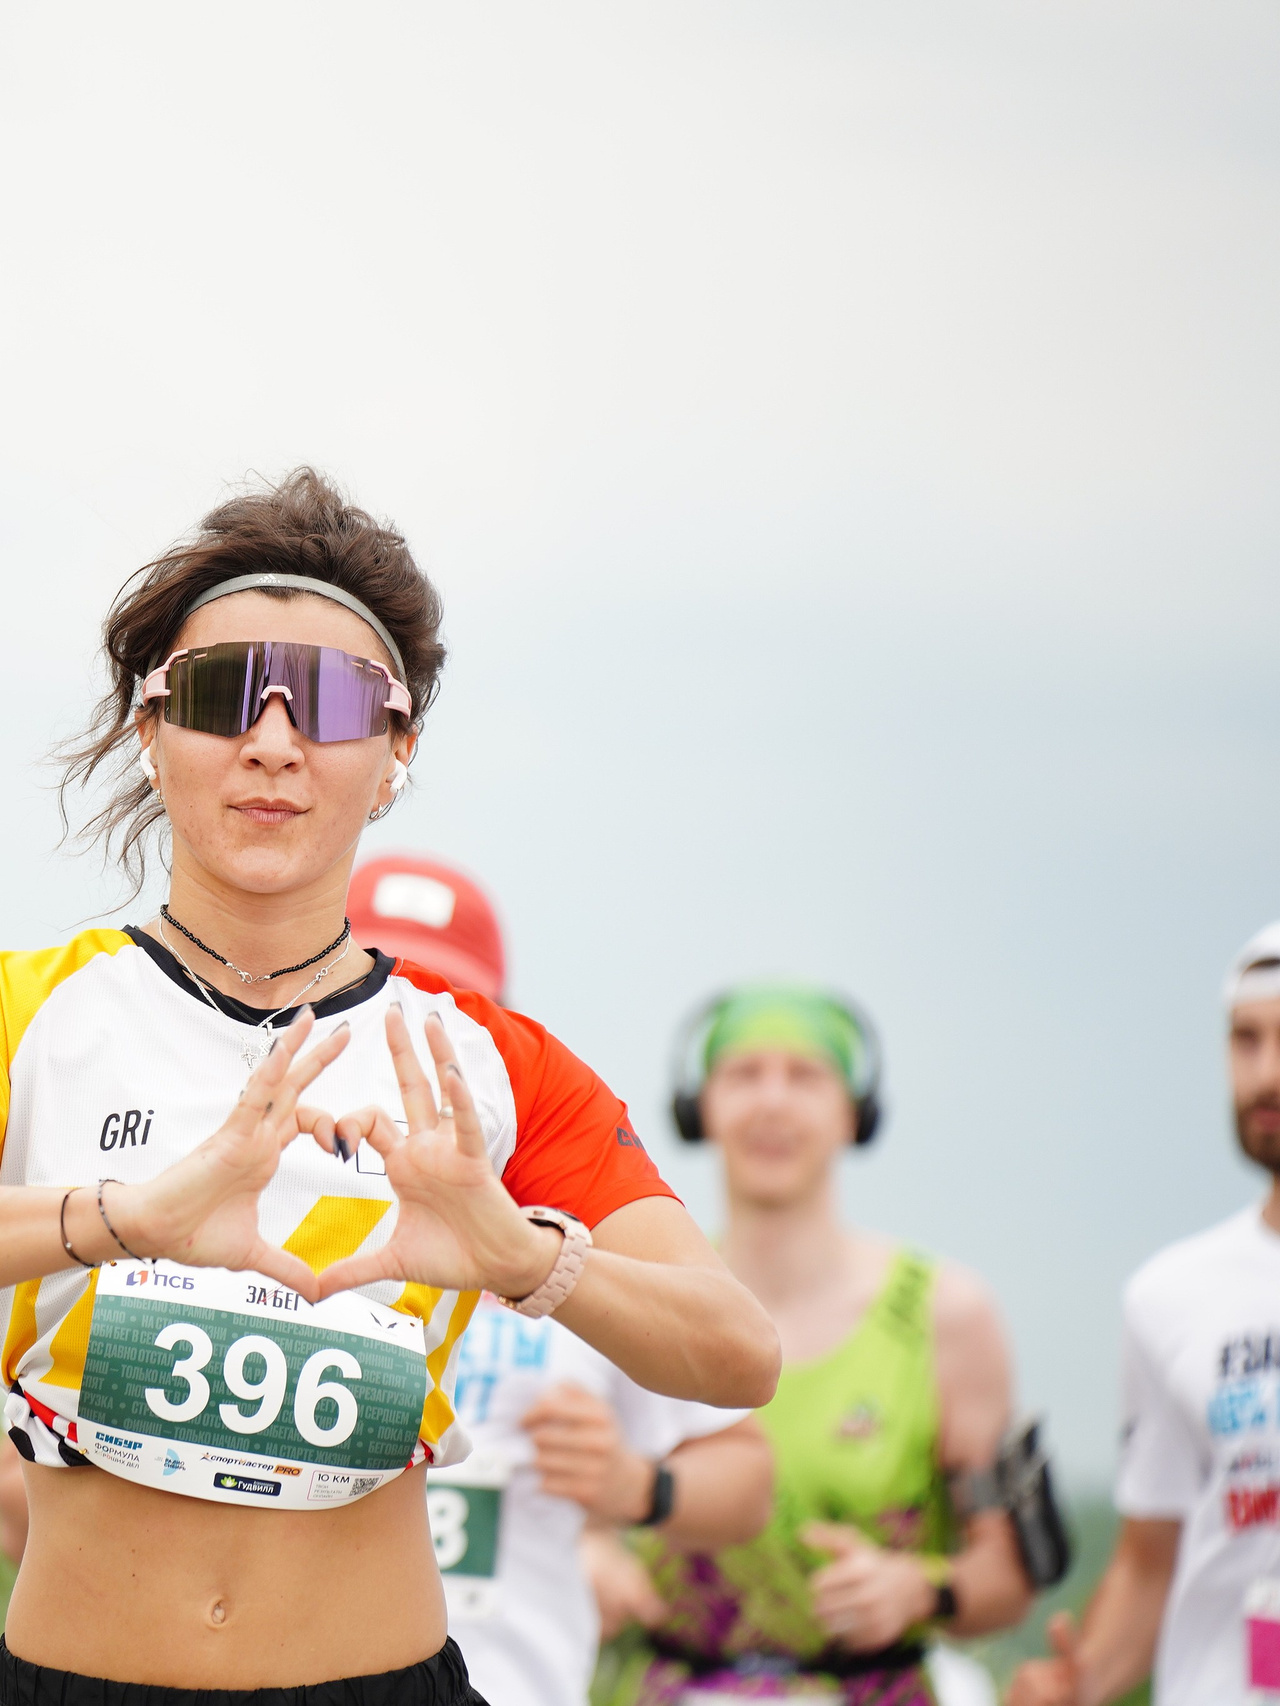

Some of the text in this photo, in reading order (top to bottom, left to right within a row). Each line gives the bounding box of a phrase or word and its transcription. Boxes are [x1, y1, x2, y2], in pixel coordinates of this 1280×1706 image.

[99, 1109, 155, 1152] GRi
[154, 1273, 195, 1290] ПСБ
[94, 1308, 126, 1324] АЧАЛО
[184, 1304, 216, 1321] РАМКИ
[114, 1326, 132, 1342] БЕГ
[276, 1320, 346, 1344] ПЕРЕЗАГРУЗКА
[103, 1342, 137, 1361] ДАВНО
[137, 1347, 175, 1367] ОТСТАЛ
[356, 1351, 394, 1370] ФИНИШ
[121, 1364, 159, 1383] ТОЛЬКО
[363, 1370, 381, 1385] ВСЕ
[381, 1372, 408, 1389] СПЯТ
[144, 1322, 363, 1448] 396
[365, 1405, 410, 1426] СЕРДЦЕМ
[95, 1432, 143, 1450] СИБУР
[123, 1417, 251, 1451] ФИНИШ ТОЛЬКО НАЧАЛО
[377, 1425, 403, 1442] ПОКА
[94, 1442, 140, 1462] ФОРМУЛА
[265, 1442, 279, 1456] НА
[279, 1444, 315, 1462] СТАРТЕ
[314, 1449, 352, 1467] ЖИЗНИ
[368, 1440, 411, 1456] БЕГОВАЯ
[275, 1465, 301, 1476] PRO
[317, 1473, 330, 1482] 10
